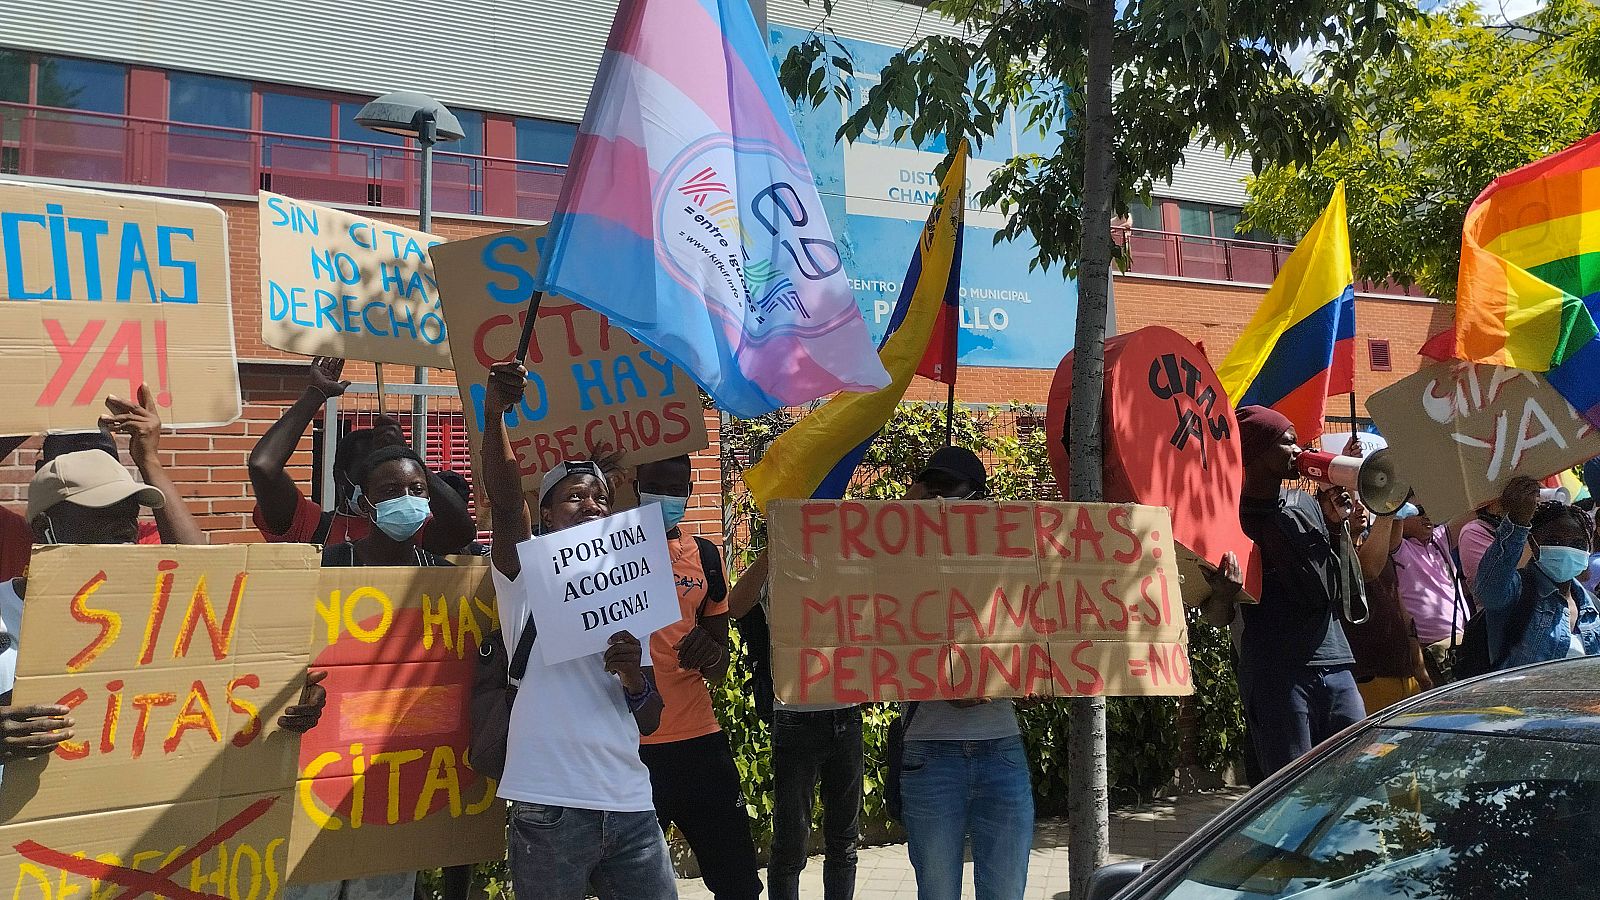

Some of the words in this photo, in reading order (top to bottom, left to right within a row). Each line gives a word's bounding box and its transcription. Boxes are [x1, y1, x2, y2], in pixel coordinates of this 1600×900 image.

[267, 197, 319, 236] SIN
[1, 203, 199, 304] CITAS
[311, 246, 361, 285] NO
[970, 288, 1032, 303] MUNICIPAL
[35, 319, 173, 407] YA!
[571, 350, 677, 410] HAY
[1148, 353, 1231, 441] CITAS
[1170, 396, 1208, 471] YA
[552, 538, 608, 575] ¡POR
[609, 525, 647, 551] UNA
[563, 556, 651, 603] ACOGIDA
[66, 559, 250, 676] SIN
[581, 590, 649, 632] DIGNA!
[800, 639, 1105, 705] PERSONAS
[50, 673, 263, 760] CITAS
